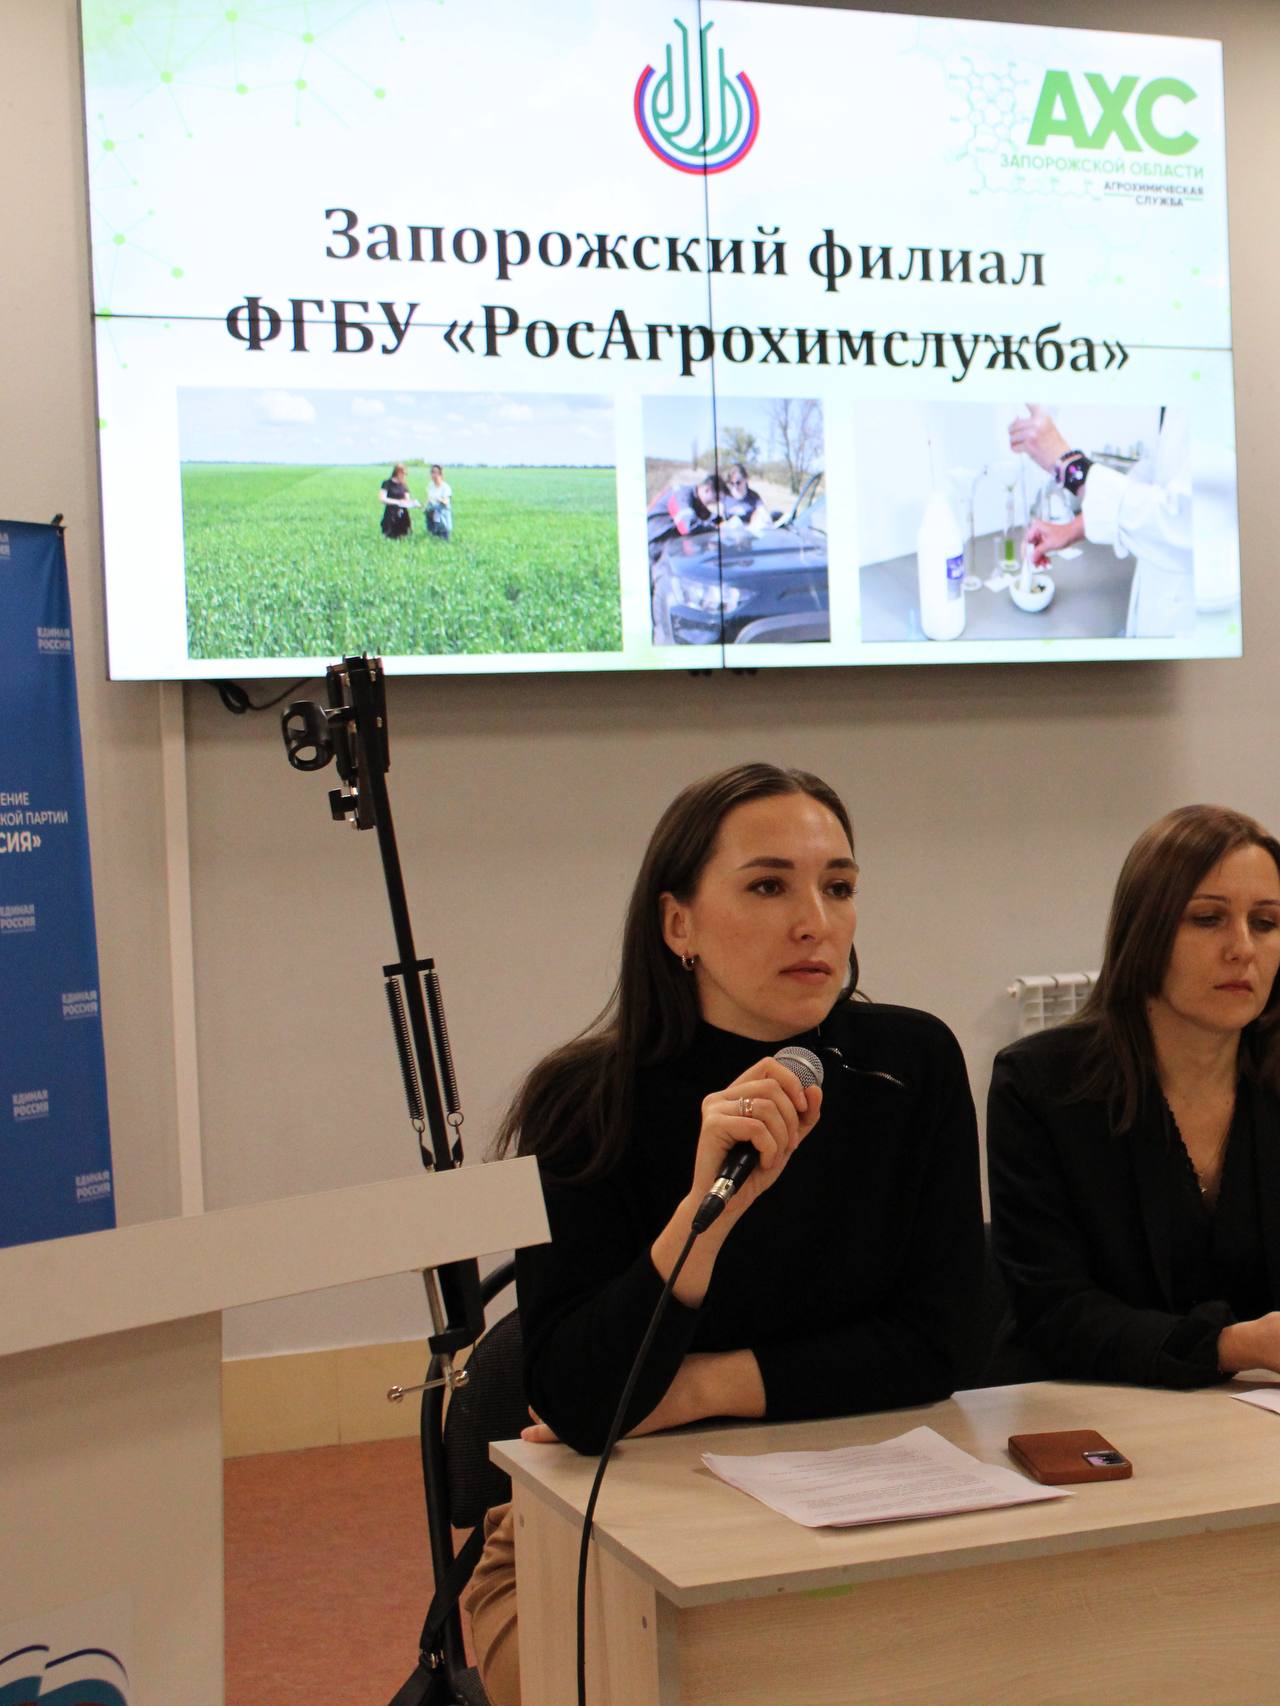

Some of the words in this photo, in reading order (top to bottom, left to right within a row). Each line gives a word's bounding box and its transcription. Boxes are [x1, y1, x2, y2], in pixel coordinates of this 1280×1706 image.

[1026, 69, 1200, 156] АХС
[1001, 153, 1125, 175] ЗАПОРОЖСКОЙ
[1129, 161, 1204, 179] ОБЛАСТИ
[1104, 180, 1203, 196] АГРОХИМИЧЕСКАЯ
[1135, 195, 1184, 207] СЛУЖБА
[324, 207, 788, 281] Запорожский
[809, 229, 1046, 292] филиал
[226, 295, 420, 355] ФГБУ
[443, 304, 1130, 383] «РосАгрохимслужба»
[26, 810, 69, 825] ПАРТИИ
